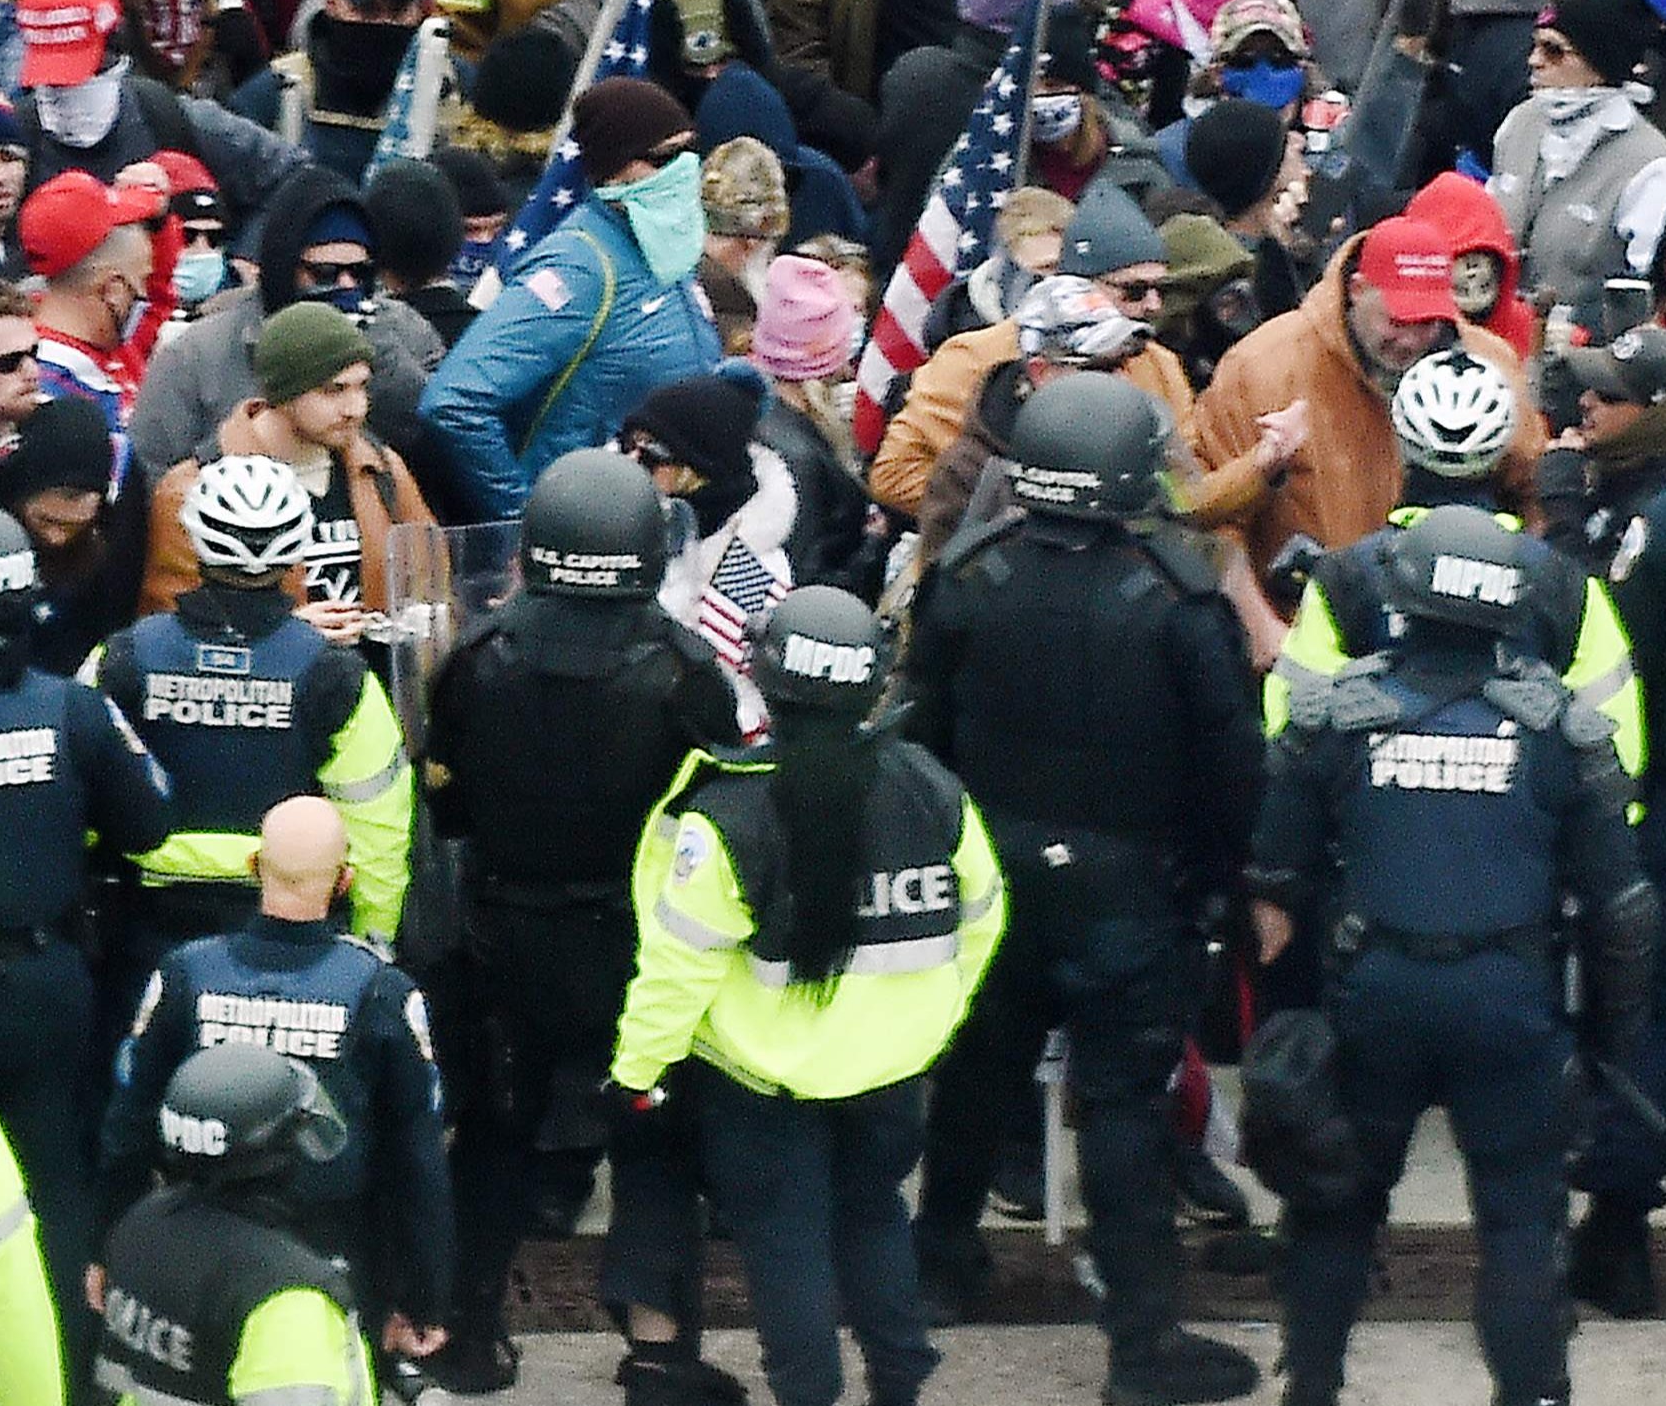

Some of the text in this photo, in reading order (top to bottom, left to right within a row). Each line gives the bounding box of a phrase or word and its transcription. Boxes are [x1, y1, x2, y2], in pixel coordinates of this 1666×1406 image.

[549, 568, 619, 586] POLICE
[783, 634, 876, 685] MPDC
[146, 673, 294, 705] METROPOLITAN
[144, 696, 293, 729] POLICE
[1370, 759, 1514, 792] POLICE
